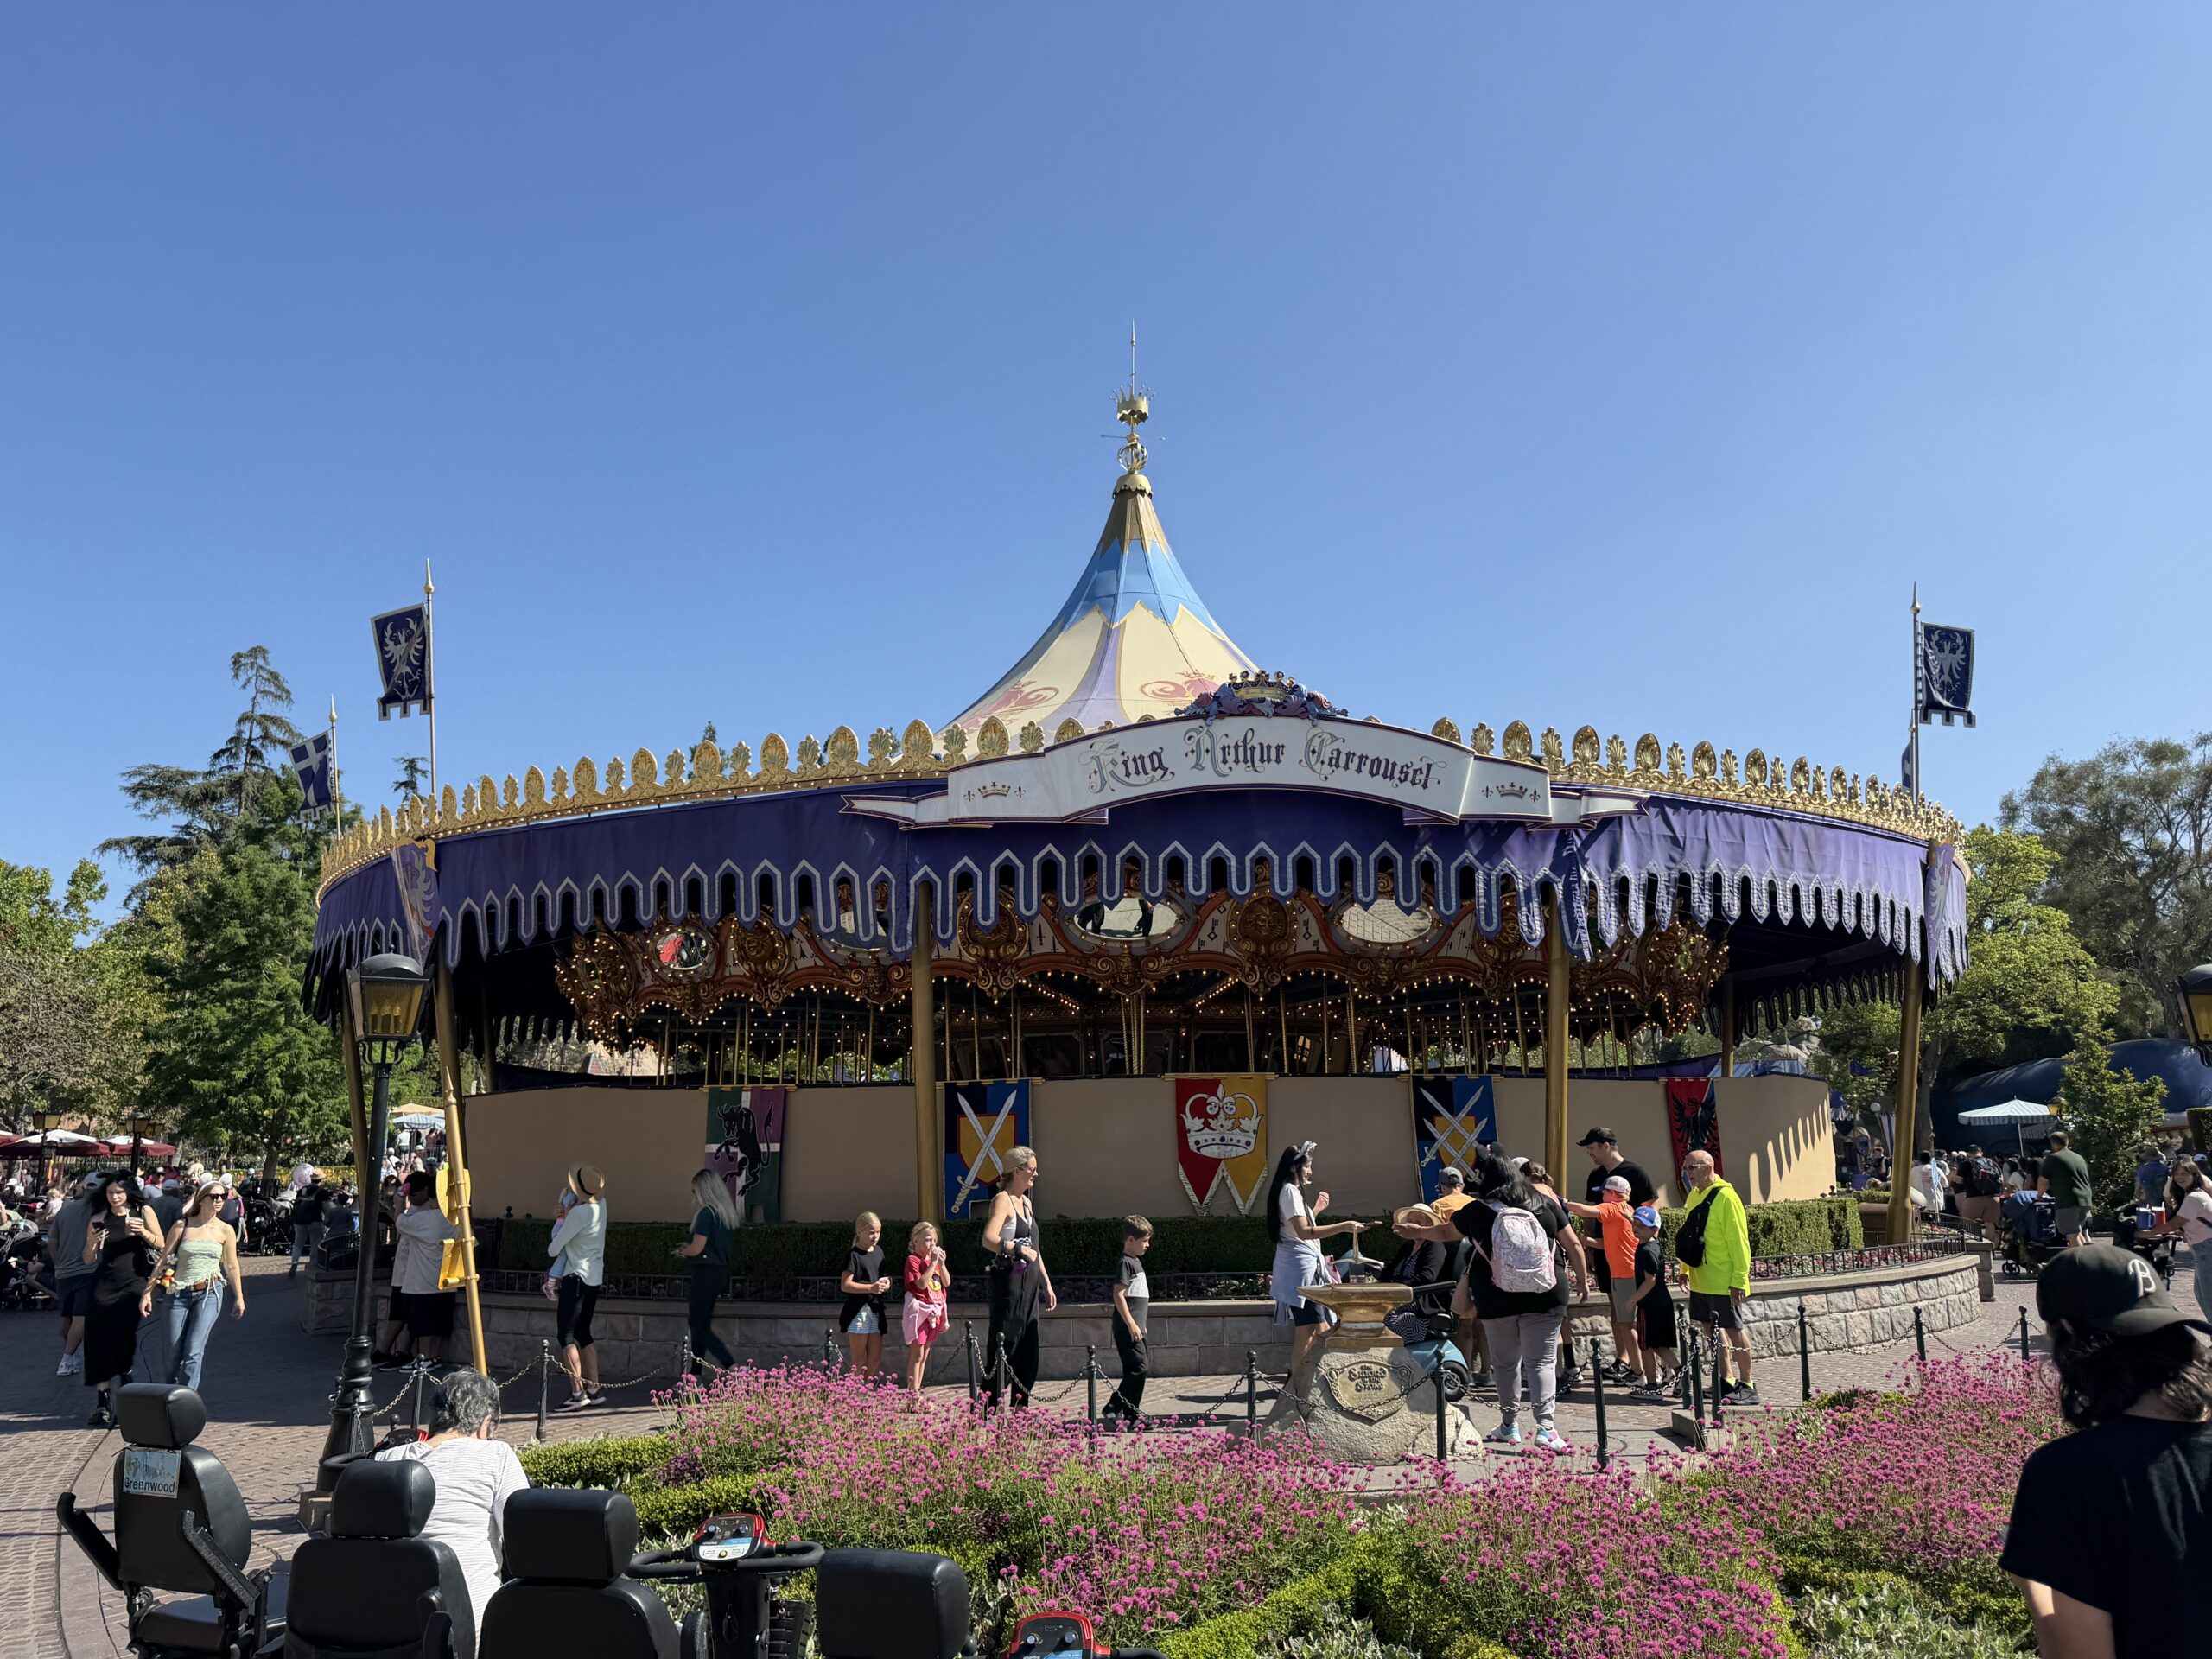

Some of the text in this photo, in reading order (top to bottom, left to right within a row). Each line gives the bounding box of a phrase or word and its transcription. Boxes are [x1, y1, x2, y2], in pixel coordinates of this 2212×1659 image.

[1079, 726, 1446, 793] King Arthur Carrousel
[2127, 1259, 2156, 1298] B
[124, 1477, 175, 1493] Greenwood
